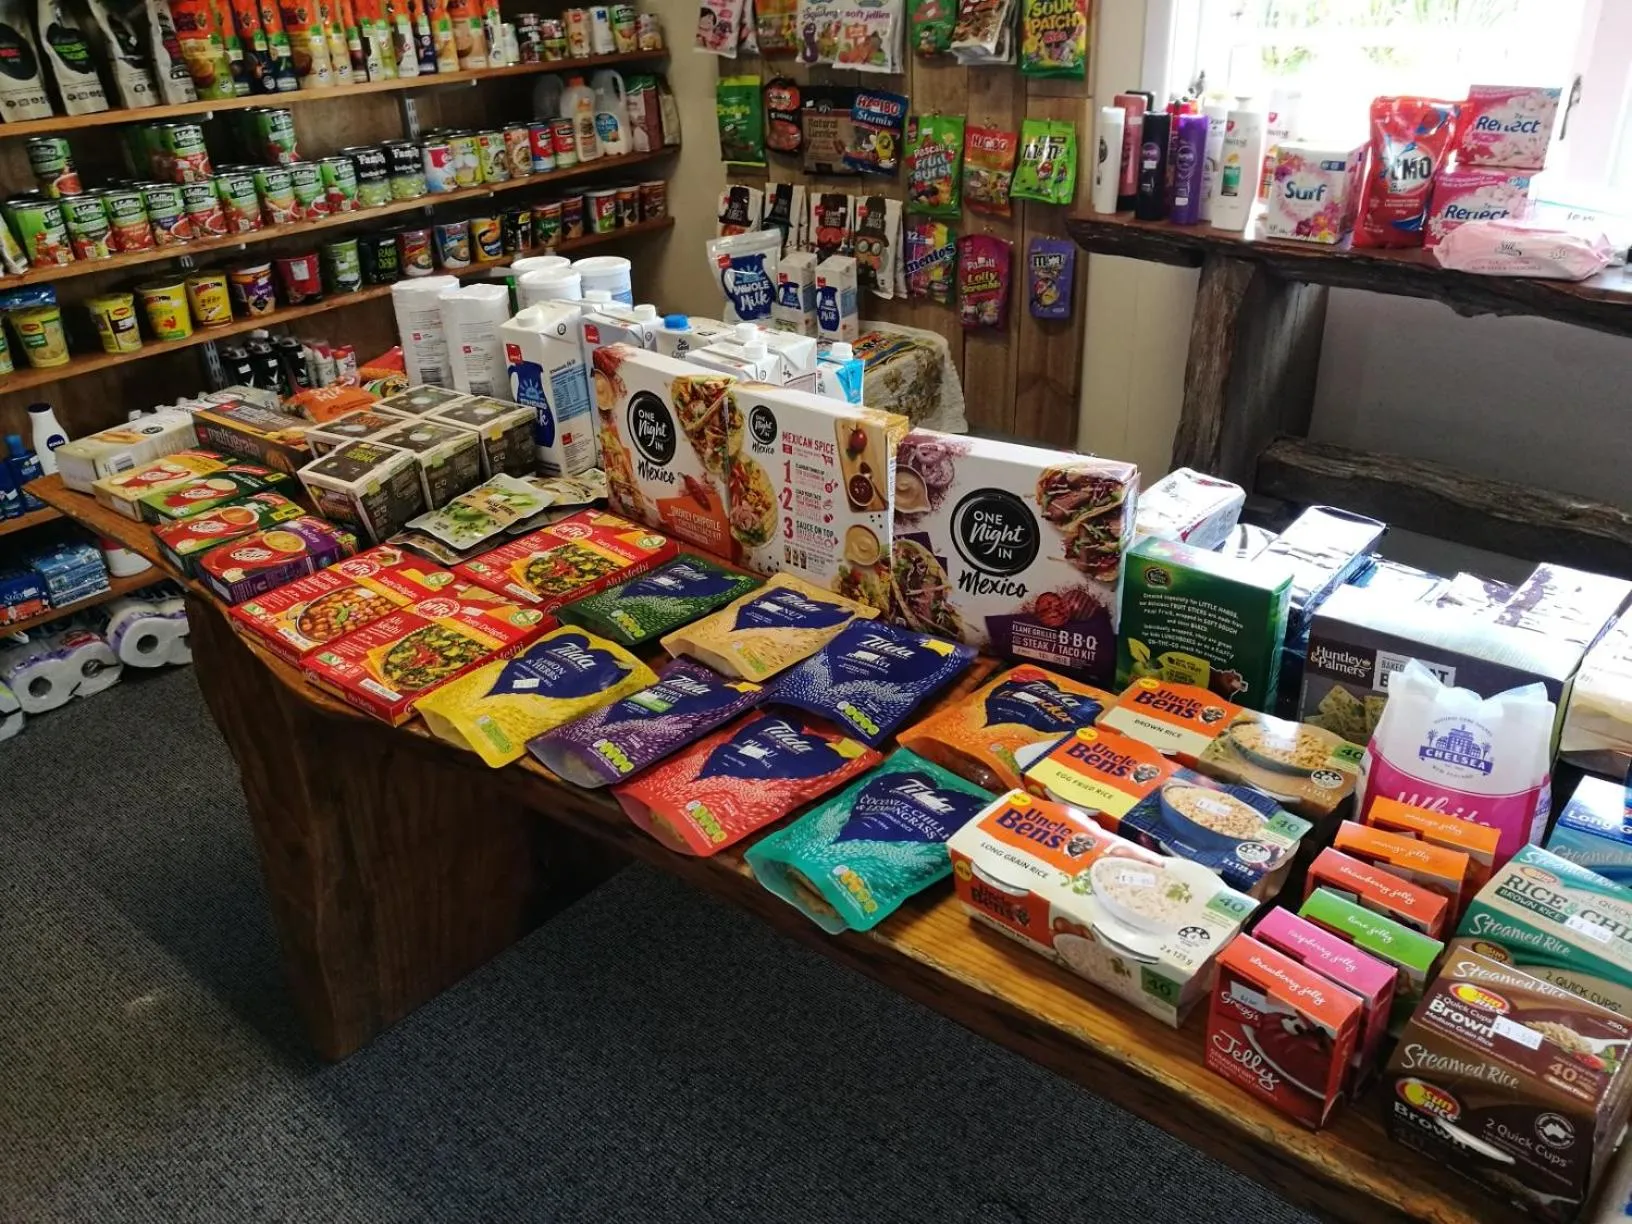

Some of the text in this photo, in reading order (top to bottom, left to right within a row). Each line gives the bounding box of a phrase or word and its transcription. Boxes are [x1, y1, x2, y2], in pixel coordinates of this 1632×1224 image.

[864, 10, 891, 21] jellies
[1032, 1, 1074, 15] SOUR
[1032, 14, 1078, 31] PATCH
[857, 94, 900, 115] HAIBO
[858, 110, 894, 127] Starmix
[1285, 181, 1327, 202] Surf
[904, 243, 957, 275] mentos
[741, 291, 770, 312] Milk
[638, 408, 655, 424] ONE
[638, 417, 669, 448] Night
[655, 438, 664, 450] IN
[782, 431, 834, 455] MEXICAN SPICE
[637, 459, 677, 486] Mexico
[784, 460, 791, 483] 1
[782, 487, 793, 512] 2
[783, 518, 794, 538] 3
[973, 510, 1003, 526] ONE
[970, 525, 1025, 555] Night
[998, 547, 1013, 561] IN
[342, 562, 374, 577] MTR
[621, 562, 649, 583] Methi
[958, 570, 1029, 599] Mexico
[422, 602, 451, 616] MTR
[1170, 602, 1187, 611] FRUIT
[1198, 601, 1218, 612] LITTLE
[1012, 624, 1032, 635] FLAME
[551, 642, 597, 670] Tilda
[860, 634, 916, 657] Tilda
[1022, 637, 1096, 662] STEAK TACO KIT
[1314, 645, 1364, 668] Huntley
[533, 662, 561, 681] HERBS
[1317, 653, 1367, 679] Palmers
[667, 675, 709, 696] Tilda
[1157, 687, 1204, 709] Uncle
[763, 720, 813, 753] Tilda
[1134, 718, 1183, 739] BROWN RICE
[1092, 742, 1138, 767] Uncle
[1340, 744, 1364, 760] 40
[1425, 747, 1487, 771] CHELSEA
[1055, 770, 1114, 800] EGG FRIED RICE
[1024, 808, 1072, 837] Uncle
[1275, 818, 1300, 834] 40
[1437, 820, 1464, 838] jelly
[1568, 809, 1614, 830] Long
[980, 842, 1048, 880] LONG GRAIN RICE
[1404, 845, 1431, 862] jelly
[1520, 850, 1593, 882] Steamed
[1339, 864, 1417, 906] strawberry jelly
[1503, 873, 1568, 910] RICE
[1217, 895, 1246, 913] 40
[1499, 887, 1566, 923] BROWN RICE
[1347, 914, 1393, 945] lime jelly
[1469, 913, 1542, 945] Steamed
[1542, 934, 1571, 956] Rice
[1160, 944, 1167, 952] 2
[1287, 927, 1358, 974] raspberry jelly
[1250, 955, 1327, 1007] strawberry jelly
[1453, 962, 1566, 999] Steamed Rice
[1545, 970, 1553, 980] 2
[1556, 977, 1588, 999] QUICK
[1428, 998, 1498, 1039] Brown
[1442, 996, 1471, 1015] Quick
[1471, 1008, 1493, 1025] Cups
[1425, 1011, 1456, 1030] Medium
[1456, 1022, 1477, 1039] Grain
[1476, 1031, 1494, 1048] Rice
[1212, 1030, 1280, 1091] Jelly
[1402, 1043, 1485, 1081] Steamed
[1487, 1065, 1520, 1090] Rice
[1549, 1063, 1578, 1082] 40
[1421, 1087, 1455, 1110] Sun
[1423, 1097, 1460, 1122] RICE
[1485, 1117, 1568, 1169] 2 Quick Cups
